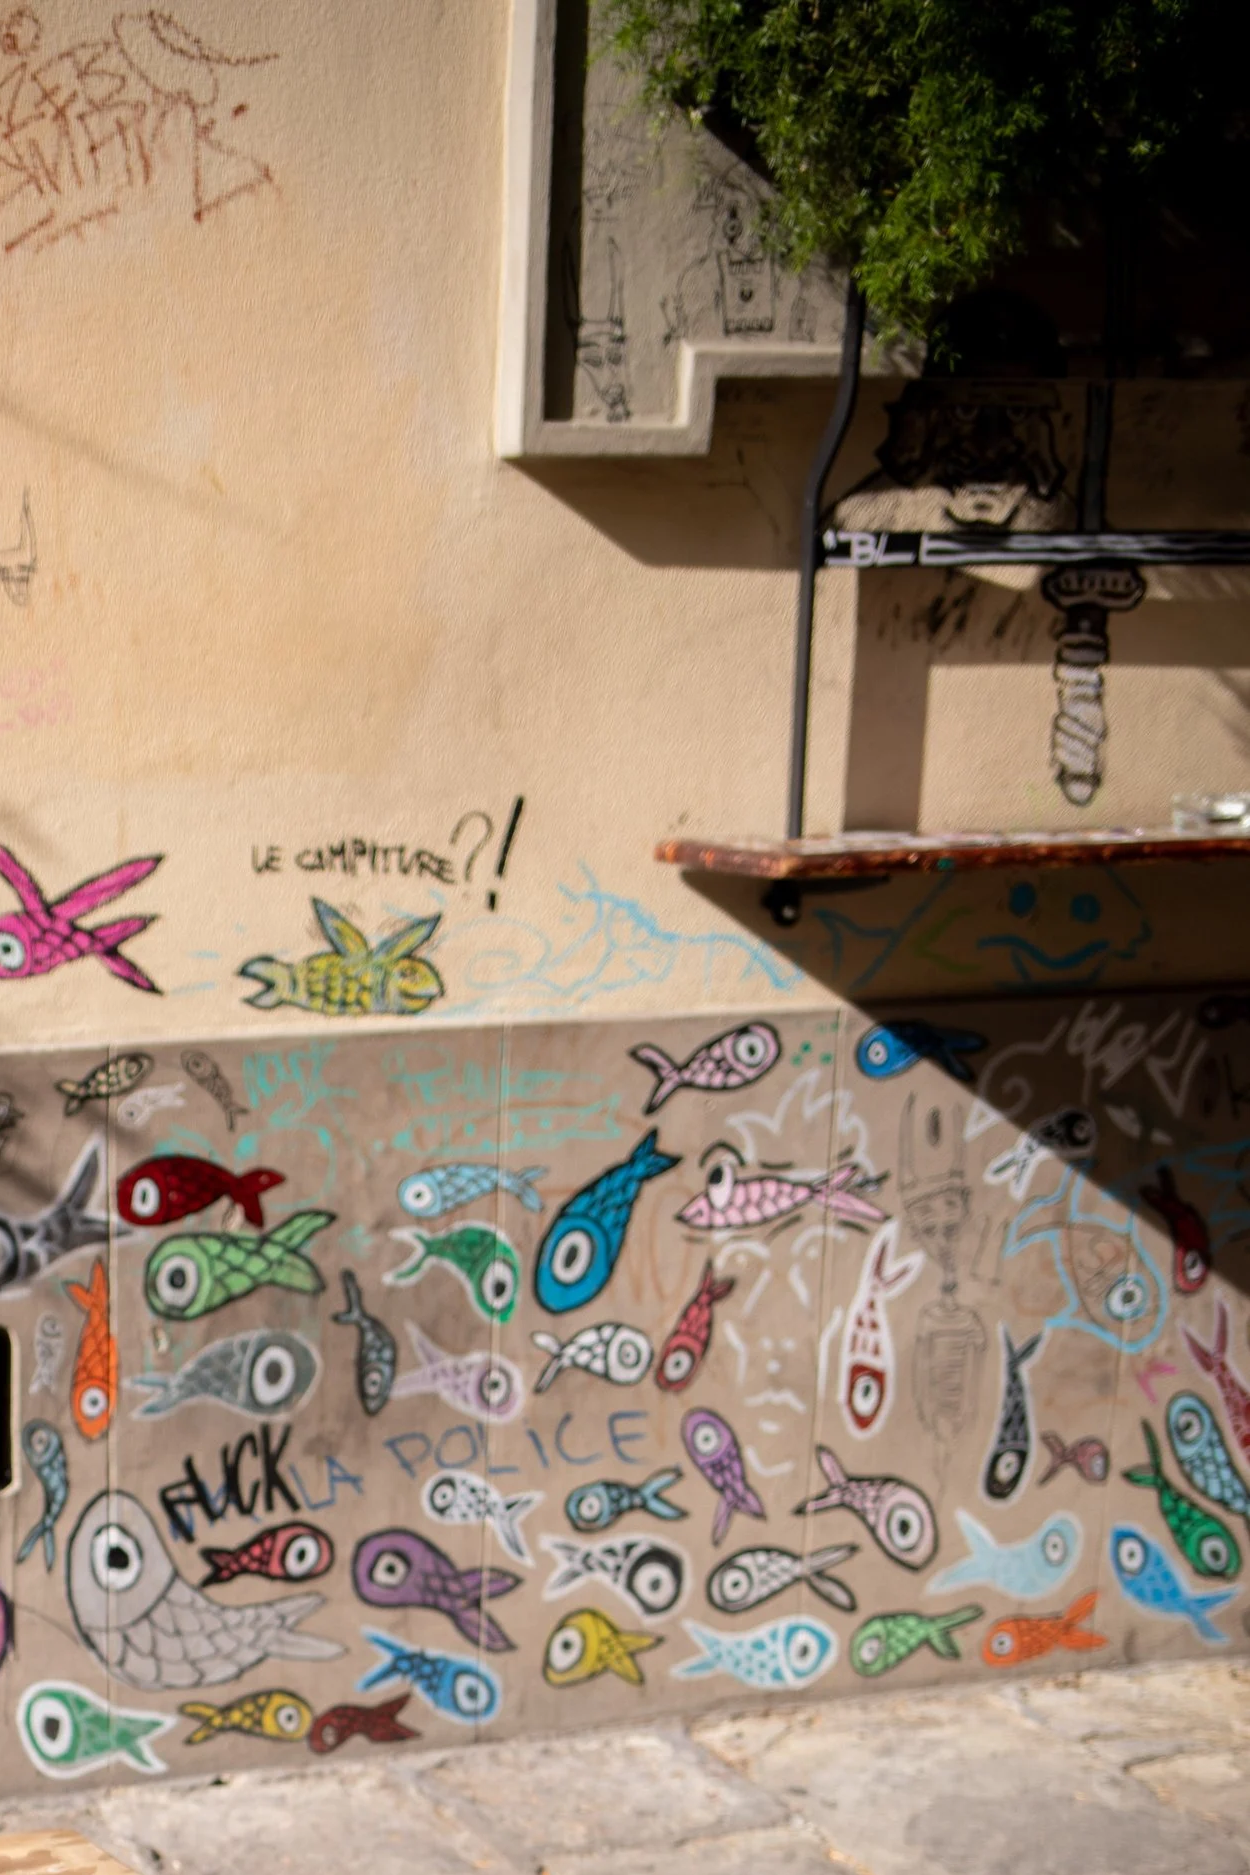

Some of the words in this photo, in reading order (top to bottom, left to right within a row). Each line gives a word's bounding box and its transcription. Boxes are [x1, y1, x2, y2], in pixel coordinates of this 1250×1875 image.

[250, 845, 282, 874] LE
[159, 1421, 301, 1543] FUCK
[287, 1454, 365, 1511] LA
[383, 1409, 649, 1480] POLICE
